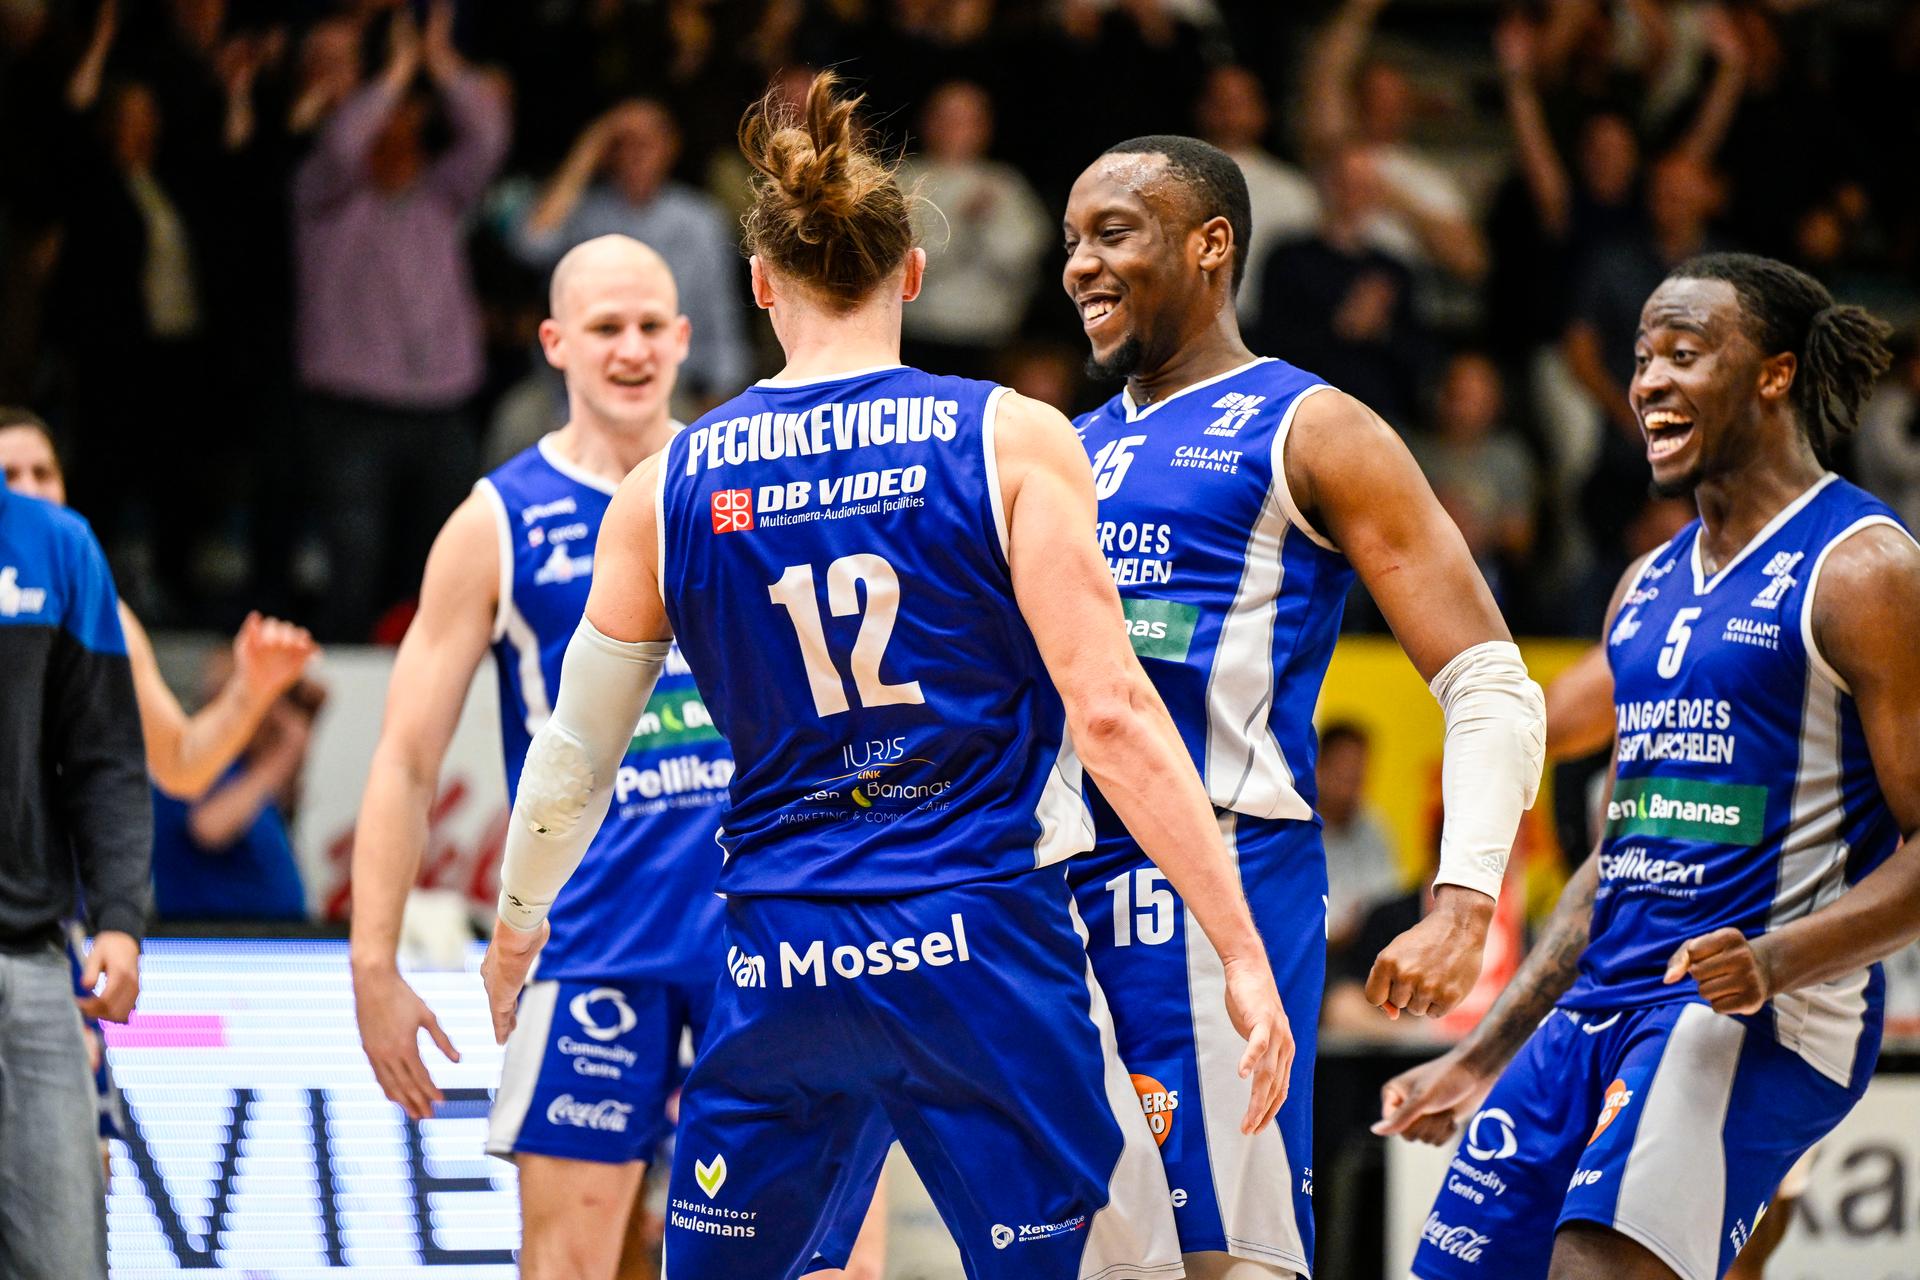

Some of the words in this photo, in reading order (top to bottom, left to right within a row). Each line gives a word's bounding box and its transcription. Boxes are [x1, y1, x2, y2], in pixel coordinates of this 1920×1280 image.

[686, 396, 958, 476] PECIUKEVICIUS
[1092, 435, 1147, 501] 15
[1170, 458, 1239, 475] INSURANCE
[1175, 446, 1243, 464] CALLANT
[757, 481, 812, 514] DB
[818, 465, 927, 505] VIDEO
[883, 496, 925, 513] facilities
[768, 553, 926, 718] 12
[1657, 607, 1702, 679] 5
[1722, 631, 1779, 651] INSURANCE
[1727, 617, 1780, 640] CALLANT
[1615, 698, 1731, 732] ANGOEROES
[858, 770, 881, 780] LINK
[867, 781, 950, 799] Bananas
[1649, 793, 1741, 827] Bananas
[1106, 868, 1174, 947] 15
[727, 946, 766, 988] Van
[779, 913, 970, 988] Mossel
[1448, 1174, 1485, 1205] Centre
[671, 1211, 756, 1238] Keulemans
[672, 1199, 757, 1220] zakenkantoor
